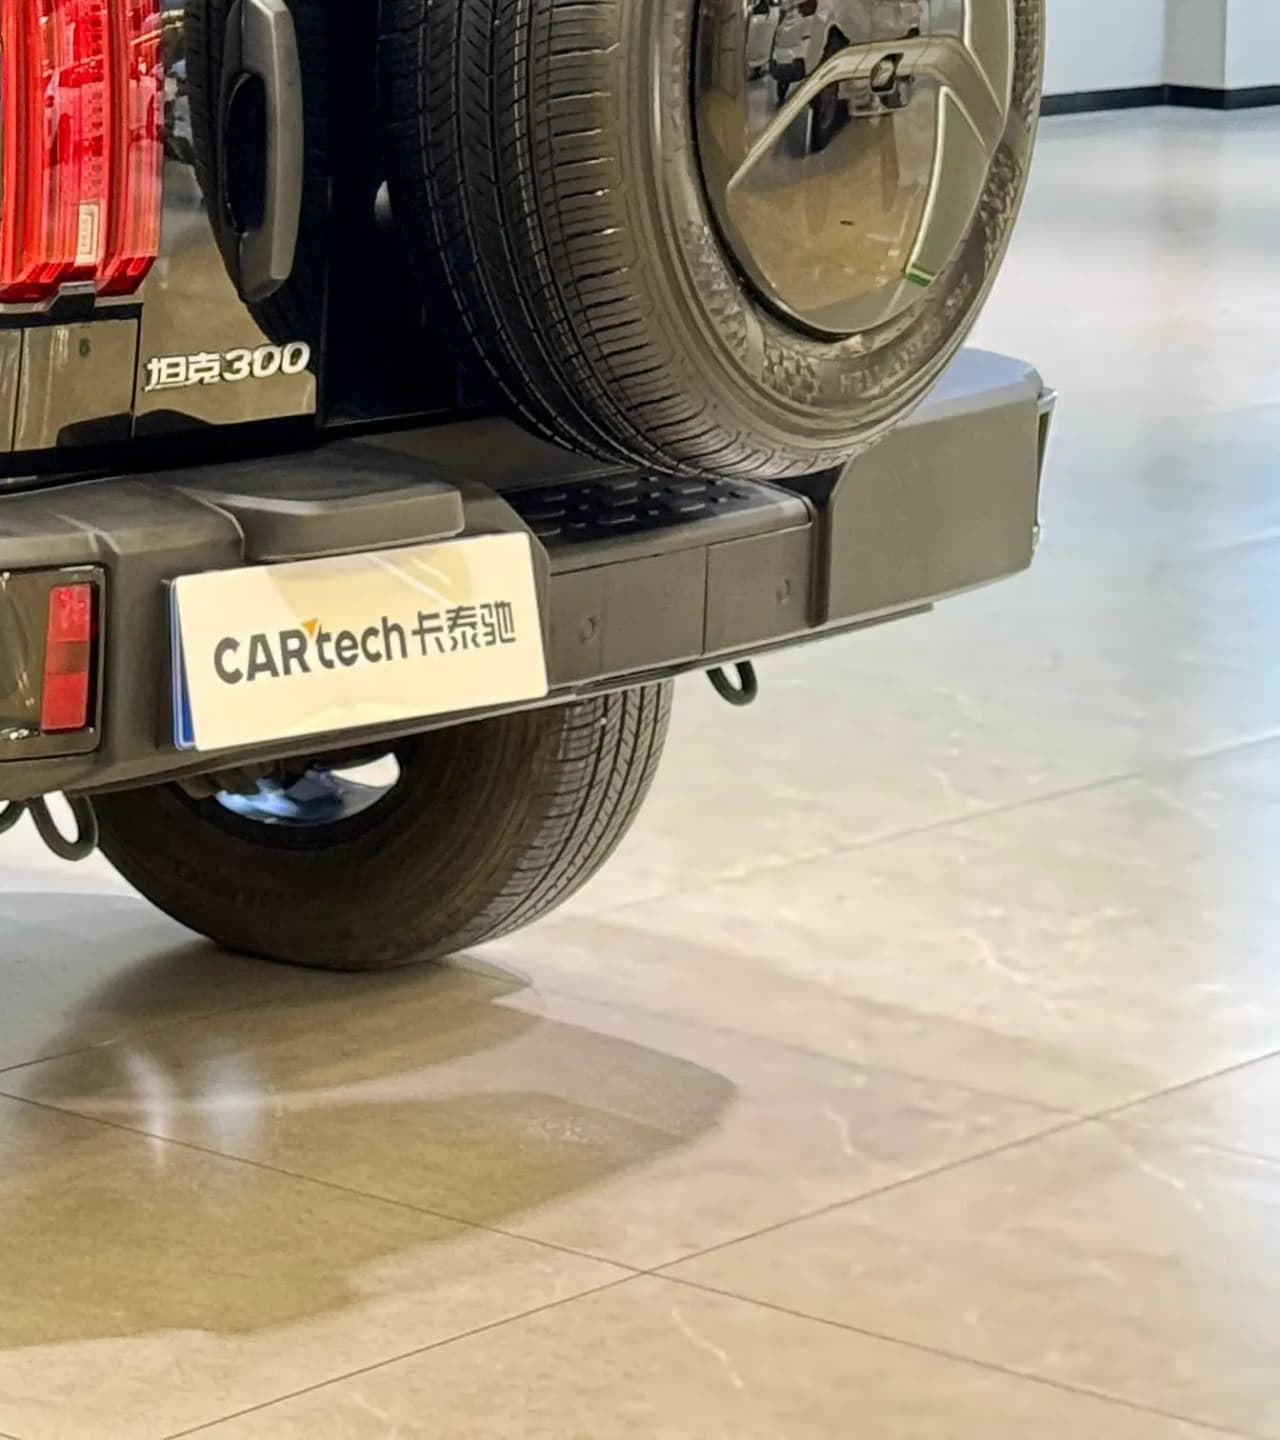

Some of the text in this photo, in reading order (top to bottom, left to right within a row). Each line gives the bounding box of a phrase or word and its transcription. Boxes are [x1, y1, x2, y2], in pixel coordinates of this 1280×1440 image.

[143, 340, 312, 393] 坦克300
[212, 600, 518, 685] CARtech 卡泰驰
